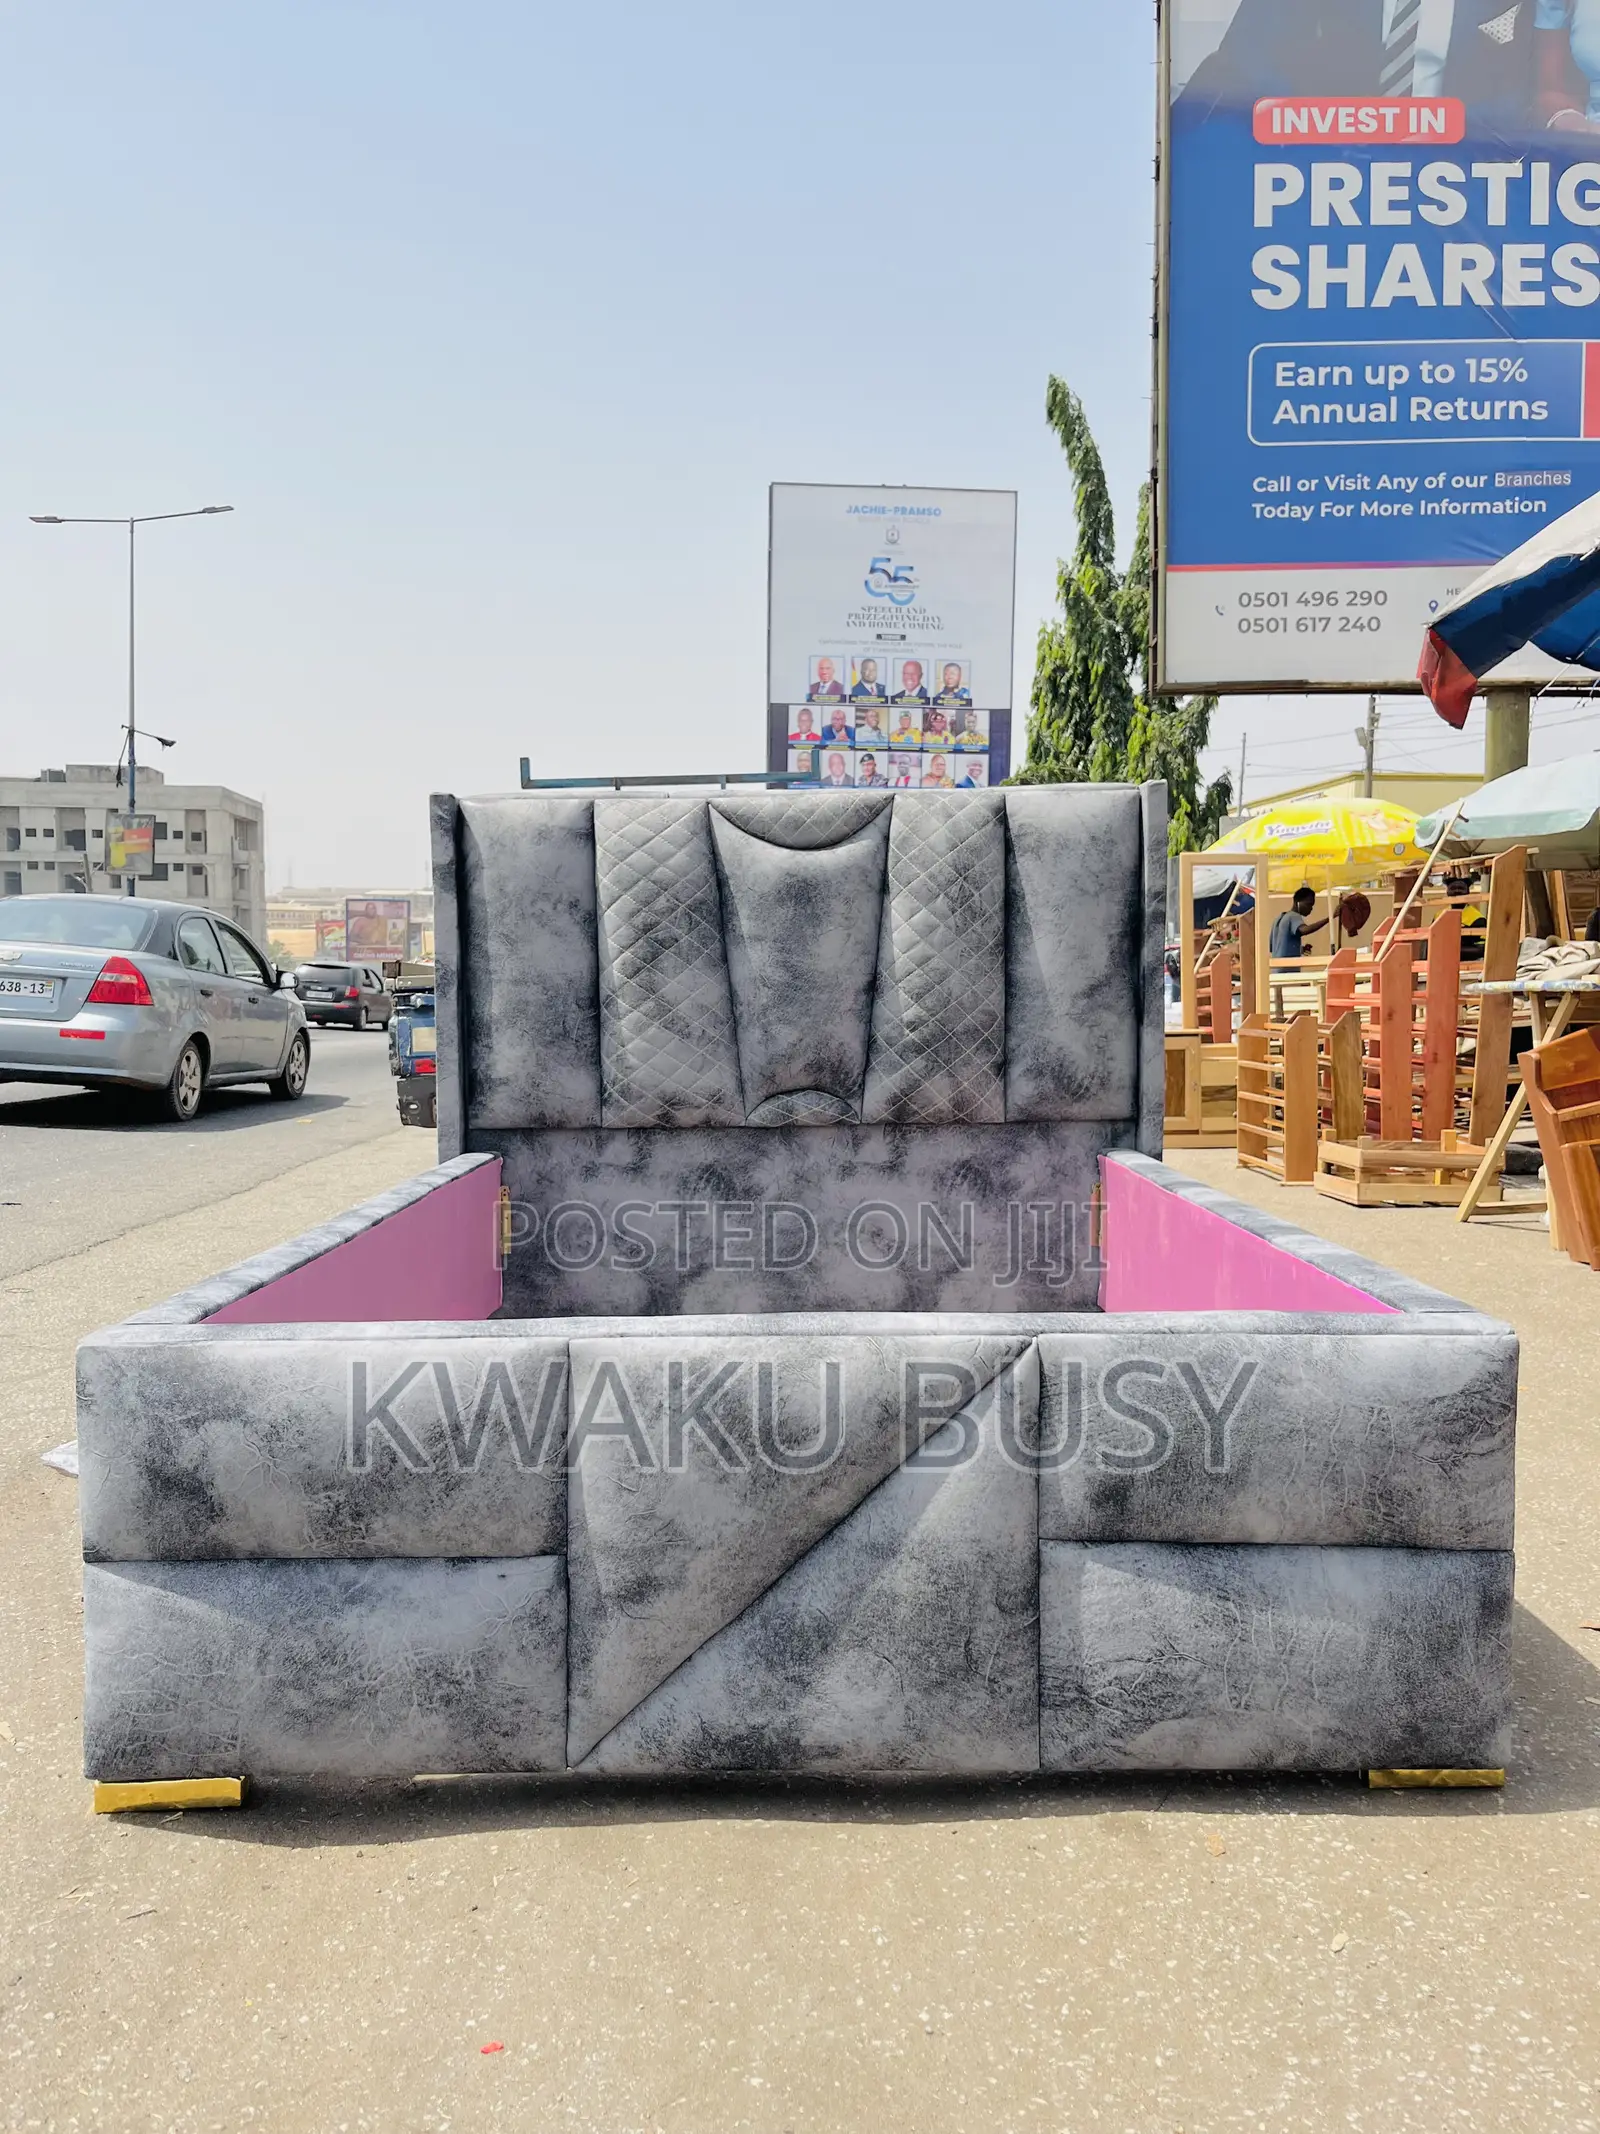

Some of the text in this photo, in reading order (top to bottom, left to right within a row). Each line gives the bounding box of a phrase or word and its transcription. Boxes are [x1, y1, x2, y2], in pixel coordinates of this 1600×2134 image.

[1272, 107, 1445, 134] INVEST IN
[1251, 242, 1600, 310] SHARES
[1275, 357, 1528, 391] Earn up to 15%
[1272, 395, 1549, 425] Annual Returns
[1252, 470, 1571, 494] Call or Visit Any of our Branches
[846, 505, 942, 517] JACHIE-PRAMSO
[1252, 497, 1547, 522] Today For More Information
[1238, 590, 1388, 609] 0501 496 290
[1446, 588, 1463, 596] HE
[860, 606, 926, 615] SPEECH AND
[922, 615, 942, 623] DAY
[845, 620, 944, 631] AND HOME COMING
[1238, 616, 1381, 635] 0501 617 240
